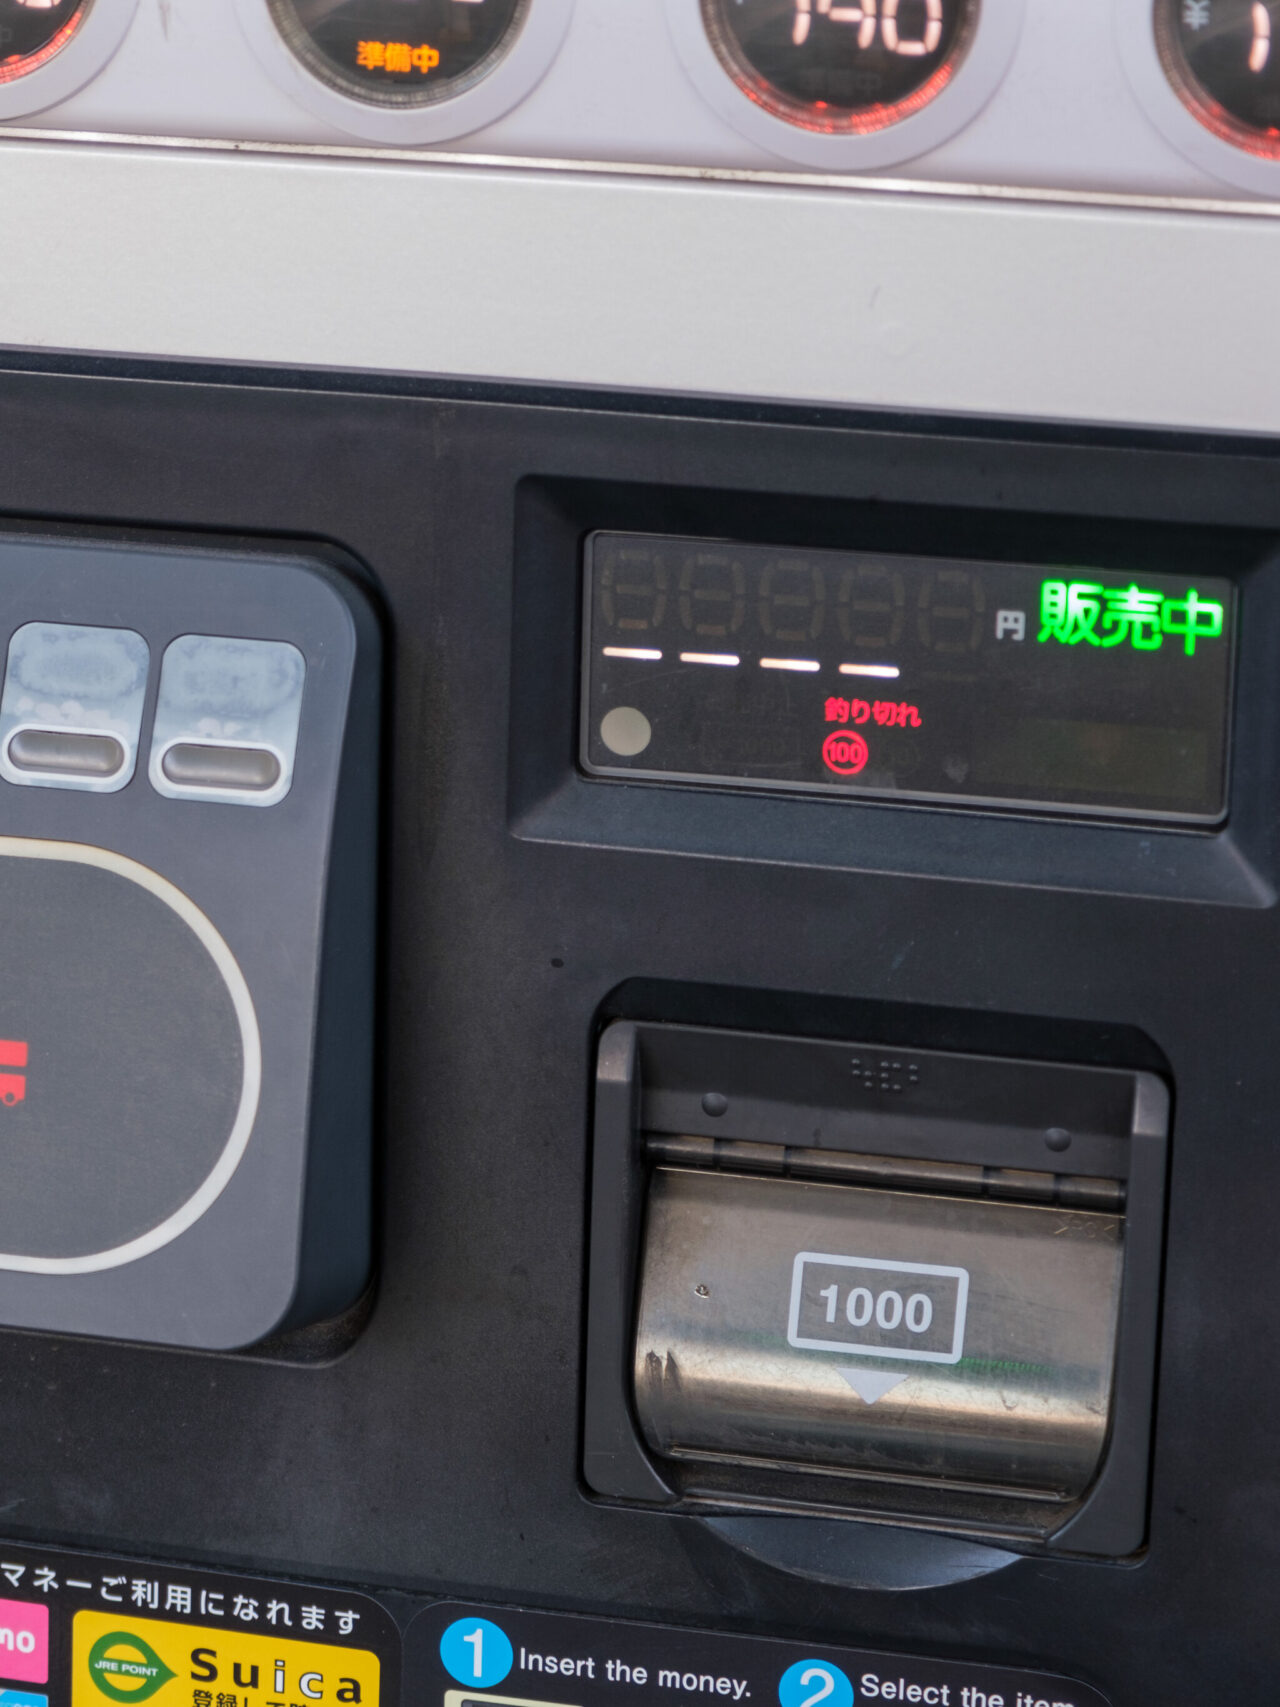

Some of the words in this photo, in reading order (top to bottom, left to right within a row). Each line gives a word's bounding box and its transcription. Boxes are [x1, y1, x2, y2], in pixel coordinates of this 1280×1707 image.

[356, 40, 440, 74] 準備中
[1036, 579, 1224, 656] 販売中
[824, 696, 922, 728] 釣り切れ
[828, 741, 862, 764] 100
[820, 1284, 933, 1333] 1000
[94, 1660, 119, 1673] JRE
[121, 1662, 159, 1678] POINT
[190, 1647, 363, 1705] Suica
[464, 1628, 483, 1678] 1
[520, 1647, 595, 1679] Insert
[605, 1659, 648, 1685] the
[658, 1669, 752, 1700] money.
[799, 1667, 836, 1707] 2
[860, 1673, 951, 1706] Select
[960, 1686, 1005, 1707] the
